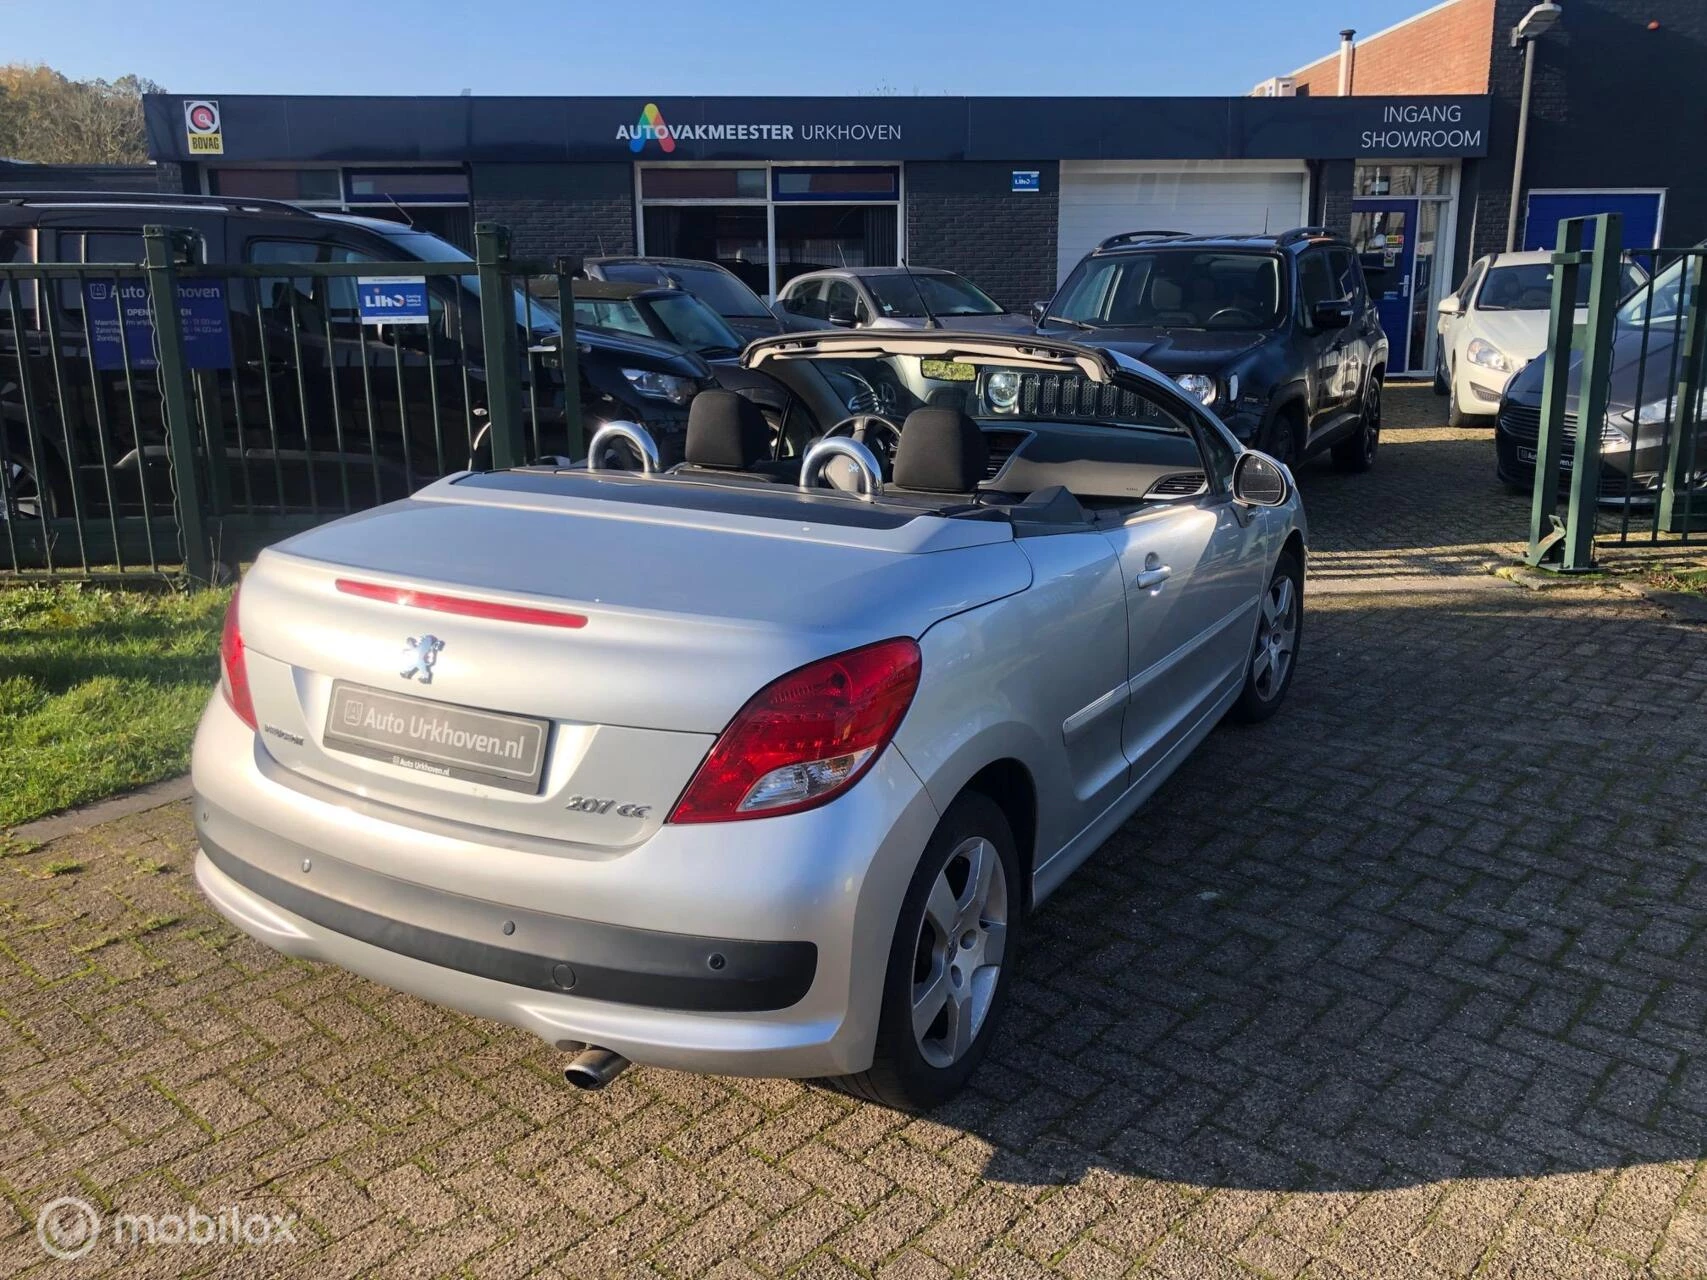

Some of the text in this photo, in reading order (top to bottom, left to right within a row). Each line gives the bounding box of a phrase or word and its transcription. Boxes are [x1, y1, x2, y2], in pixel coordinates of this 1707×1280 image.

[1384, 105, 1462, 122] INGANG
[616, 125, 901, 140] AUTOVAKMEESTER URKHOVEN
[1361, 130, 1480, 148] SHOWROOM
[192, 137, 220, 150] BOVAG
[110, 285, 145, 298] Auto
[364, 707, 525, 759] Auto Urkhoven.nl
[400, 758, 414, 768] Auto
[566, 796, 616, 815] 207
